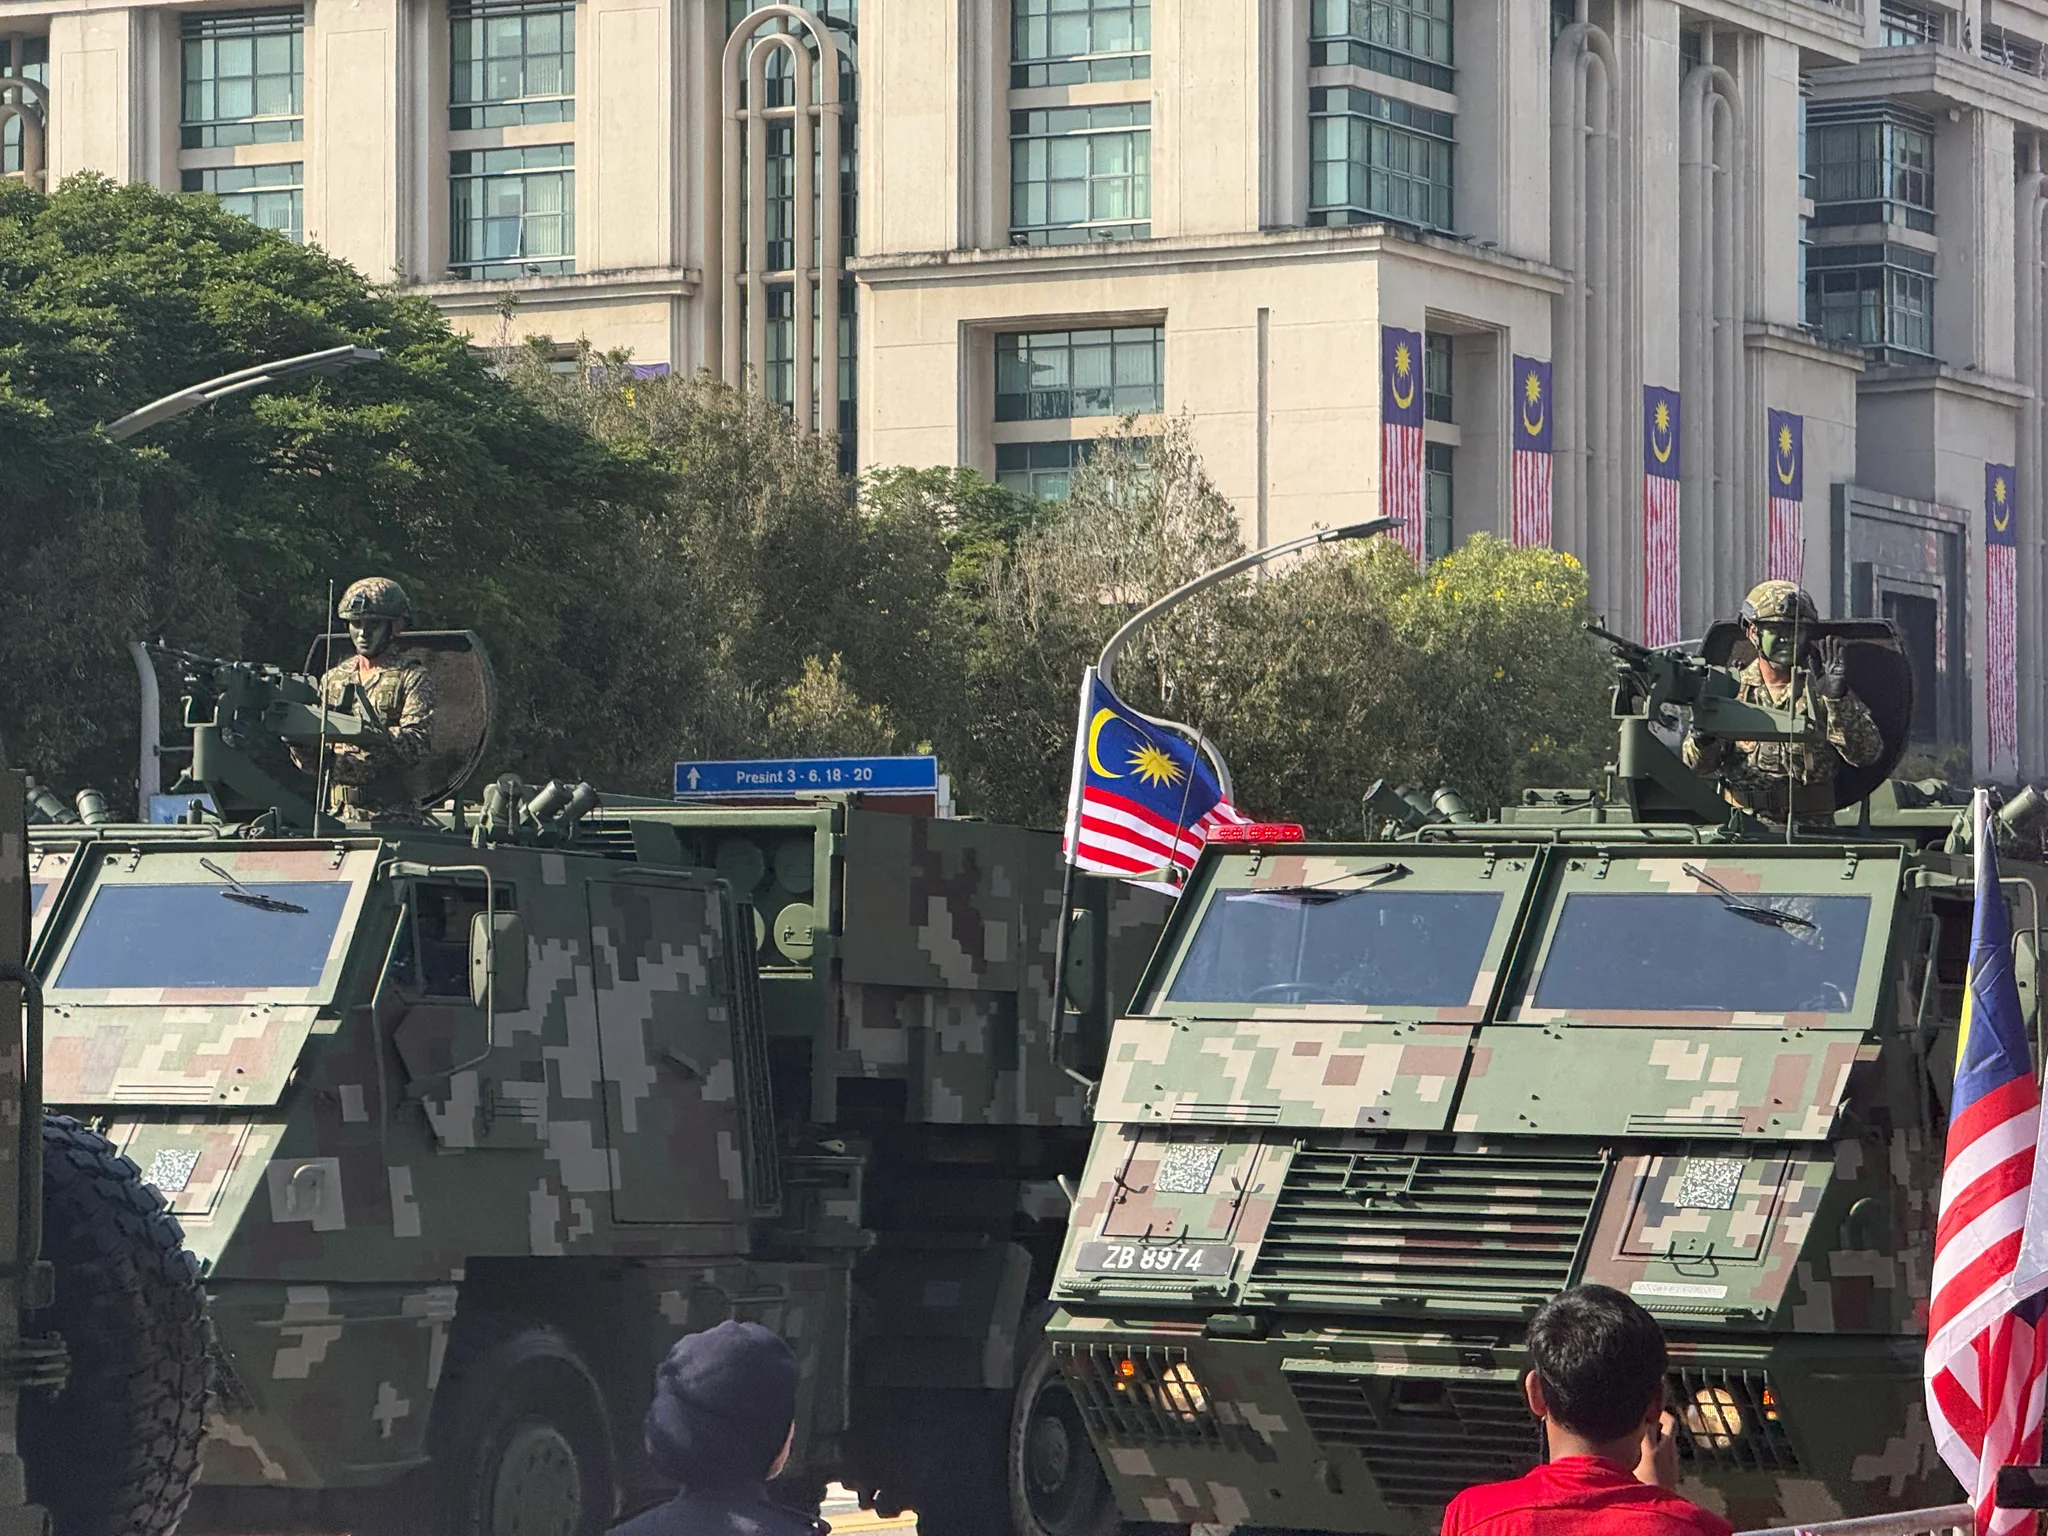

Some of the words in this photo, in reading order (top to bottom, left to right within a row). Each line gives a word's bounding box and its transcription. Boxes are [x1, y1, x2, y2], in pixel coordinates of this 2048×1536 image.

[736, 770, 783, 784] Presint
[787, 769, 796, 783] 3
[826, 768, 841, 782] 18
[853, 767, 873, 781] 20
[1102, 1245, 1136, 1269] ZB
[1139, 1246, 1204, 1271] 8974
